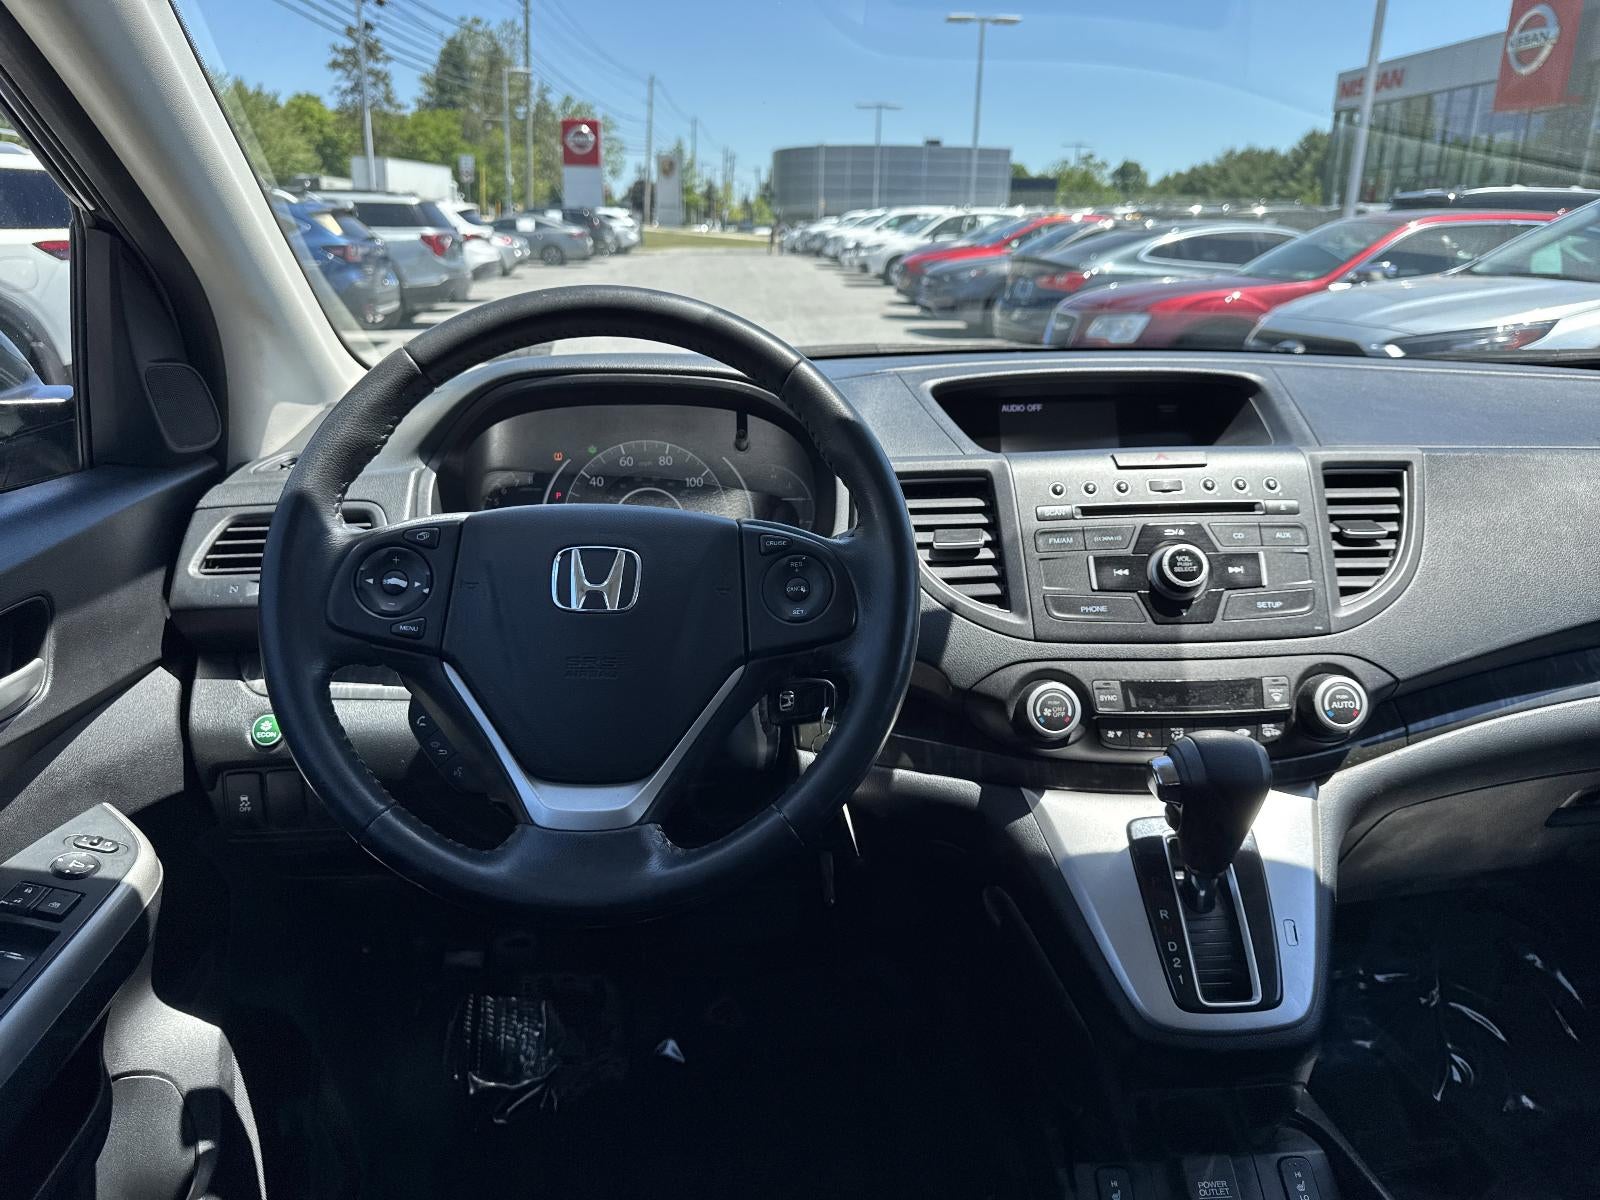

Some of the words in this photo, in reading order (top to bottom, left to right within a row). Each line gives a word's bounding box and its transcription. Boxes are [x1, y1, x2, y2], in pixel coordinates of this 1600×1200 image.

[1340, 68, 1406, 97] NISAN
[1001, 404, 1025, 413] AUDIO
[1027, 403, 1042, 412] OFF
[619, 456, 634, 467] 60
[658, 455, 673, 466] 80
[589, 476, 605, 487] 40
[685, 476, 704, 488] 100
[555, 491, 562, 500] P
[1232, 532, 1245, 540] CD
[1275, 531, 1292, 539] AUX
[1080, 605, 1108, 613] PHONE
[1256, 601, 1283, 609] SETUP
[399, 625, 419, 633] MENU
[1099, 694, 1118, 702] SYNC
[1331, 700, 1355, 709] AUTO
[256, 731, 277, 739] ECON
[1159, 909, 1170, 920] R
[1167, 941, 1178, 952] D
[1172, 957, 1182, 968] 2
[1178, 974, 1184, 985] 1
[1197, 1180, 1228, 1189] POWER
[1199, 1188, 1230, 1197] OUTLET
